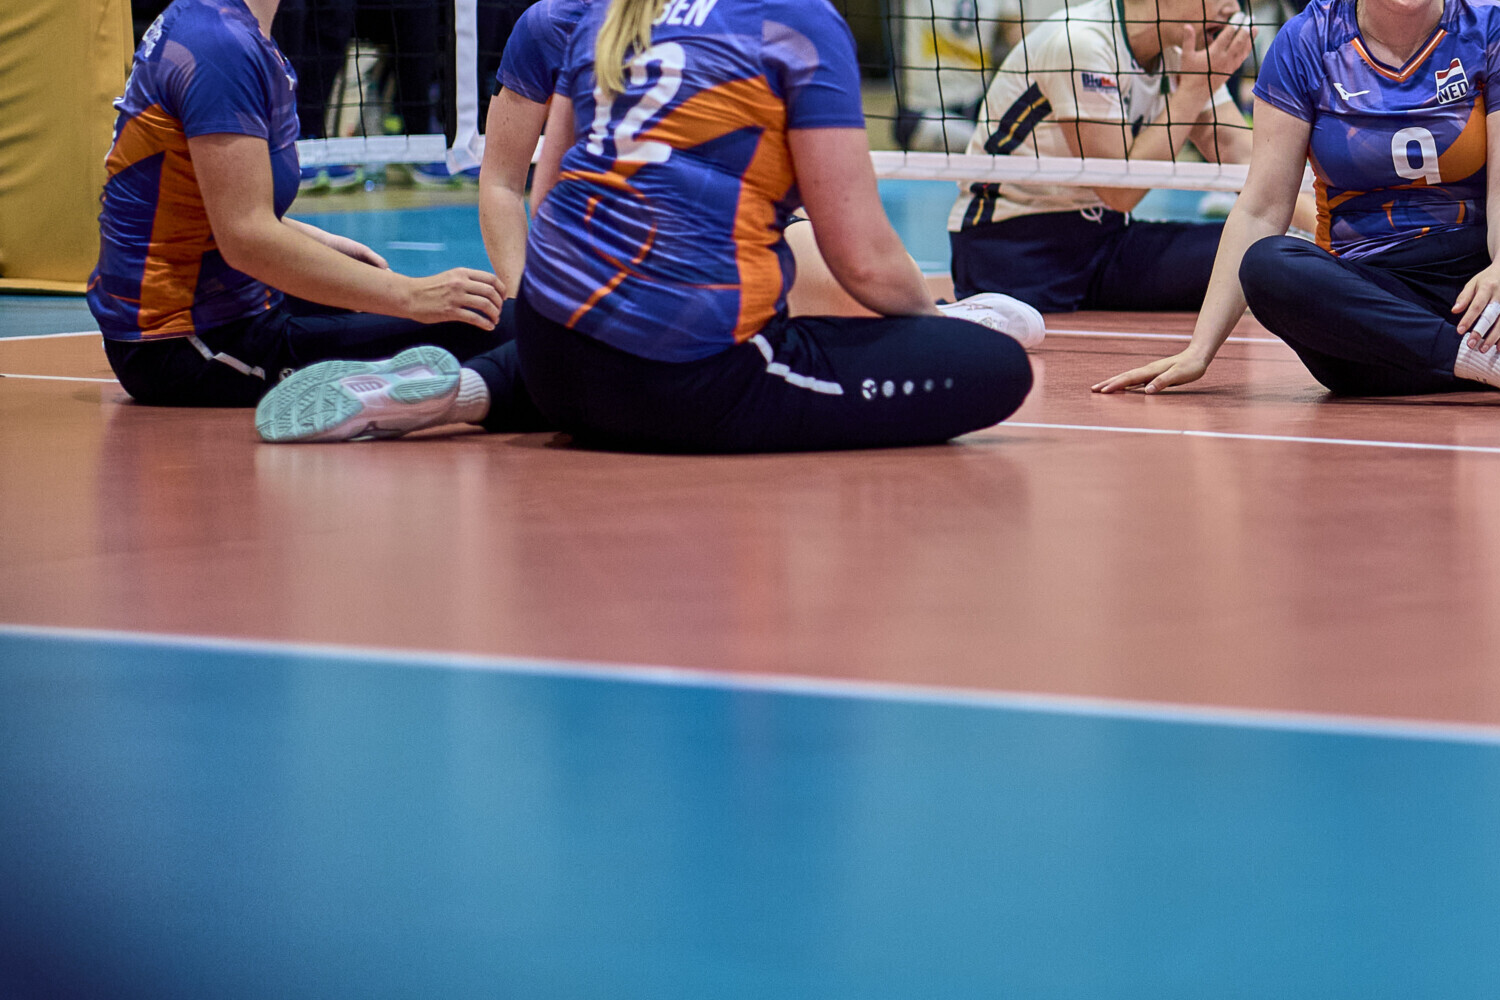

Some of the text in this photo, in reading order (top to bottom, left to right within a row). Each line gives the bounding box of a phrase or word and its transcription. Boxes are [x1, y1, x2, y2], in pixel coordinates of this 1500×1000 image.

[586, 42, 686, 163] 12
[1438, 81, 1469, 103] NED
[1391, 127, 1442, 185] 9
